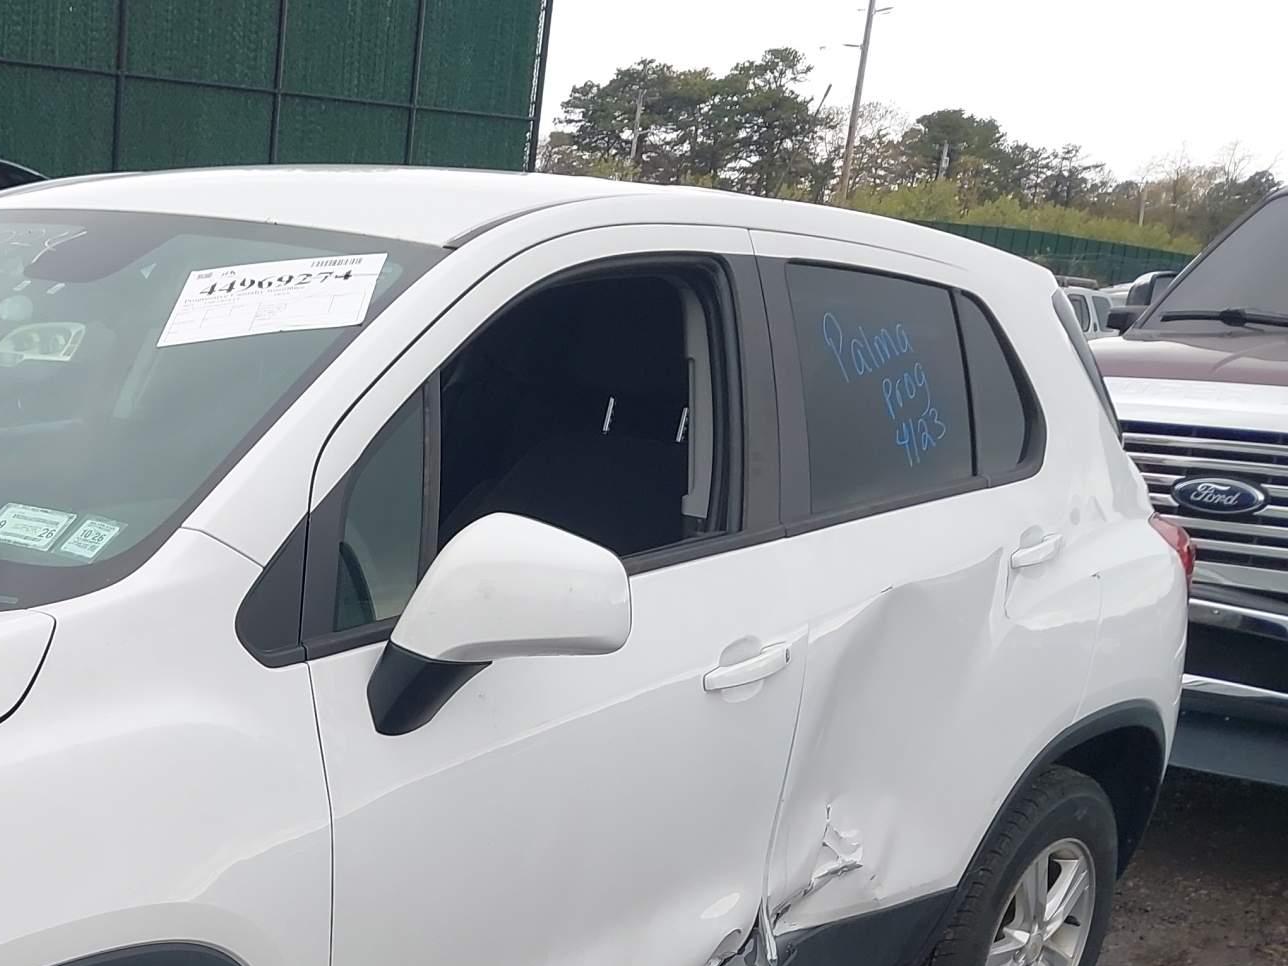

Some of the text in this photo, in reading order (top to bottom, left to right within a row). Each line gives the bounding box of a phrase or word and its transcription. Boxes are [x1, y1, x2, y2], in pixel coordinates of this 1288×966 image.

[199, 270, 353, 295] 44969274
[823, 312, 912, 382] Palma
[896, 408, 946, 467] 4/23
[1190, 483, 1240, 505] Ford
[38, 528, 56, 539] 26
[79, 529, 107, 543] 10 26
